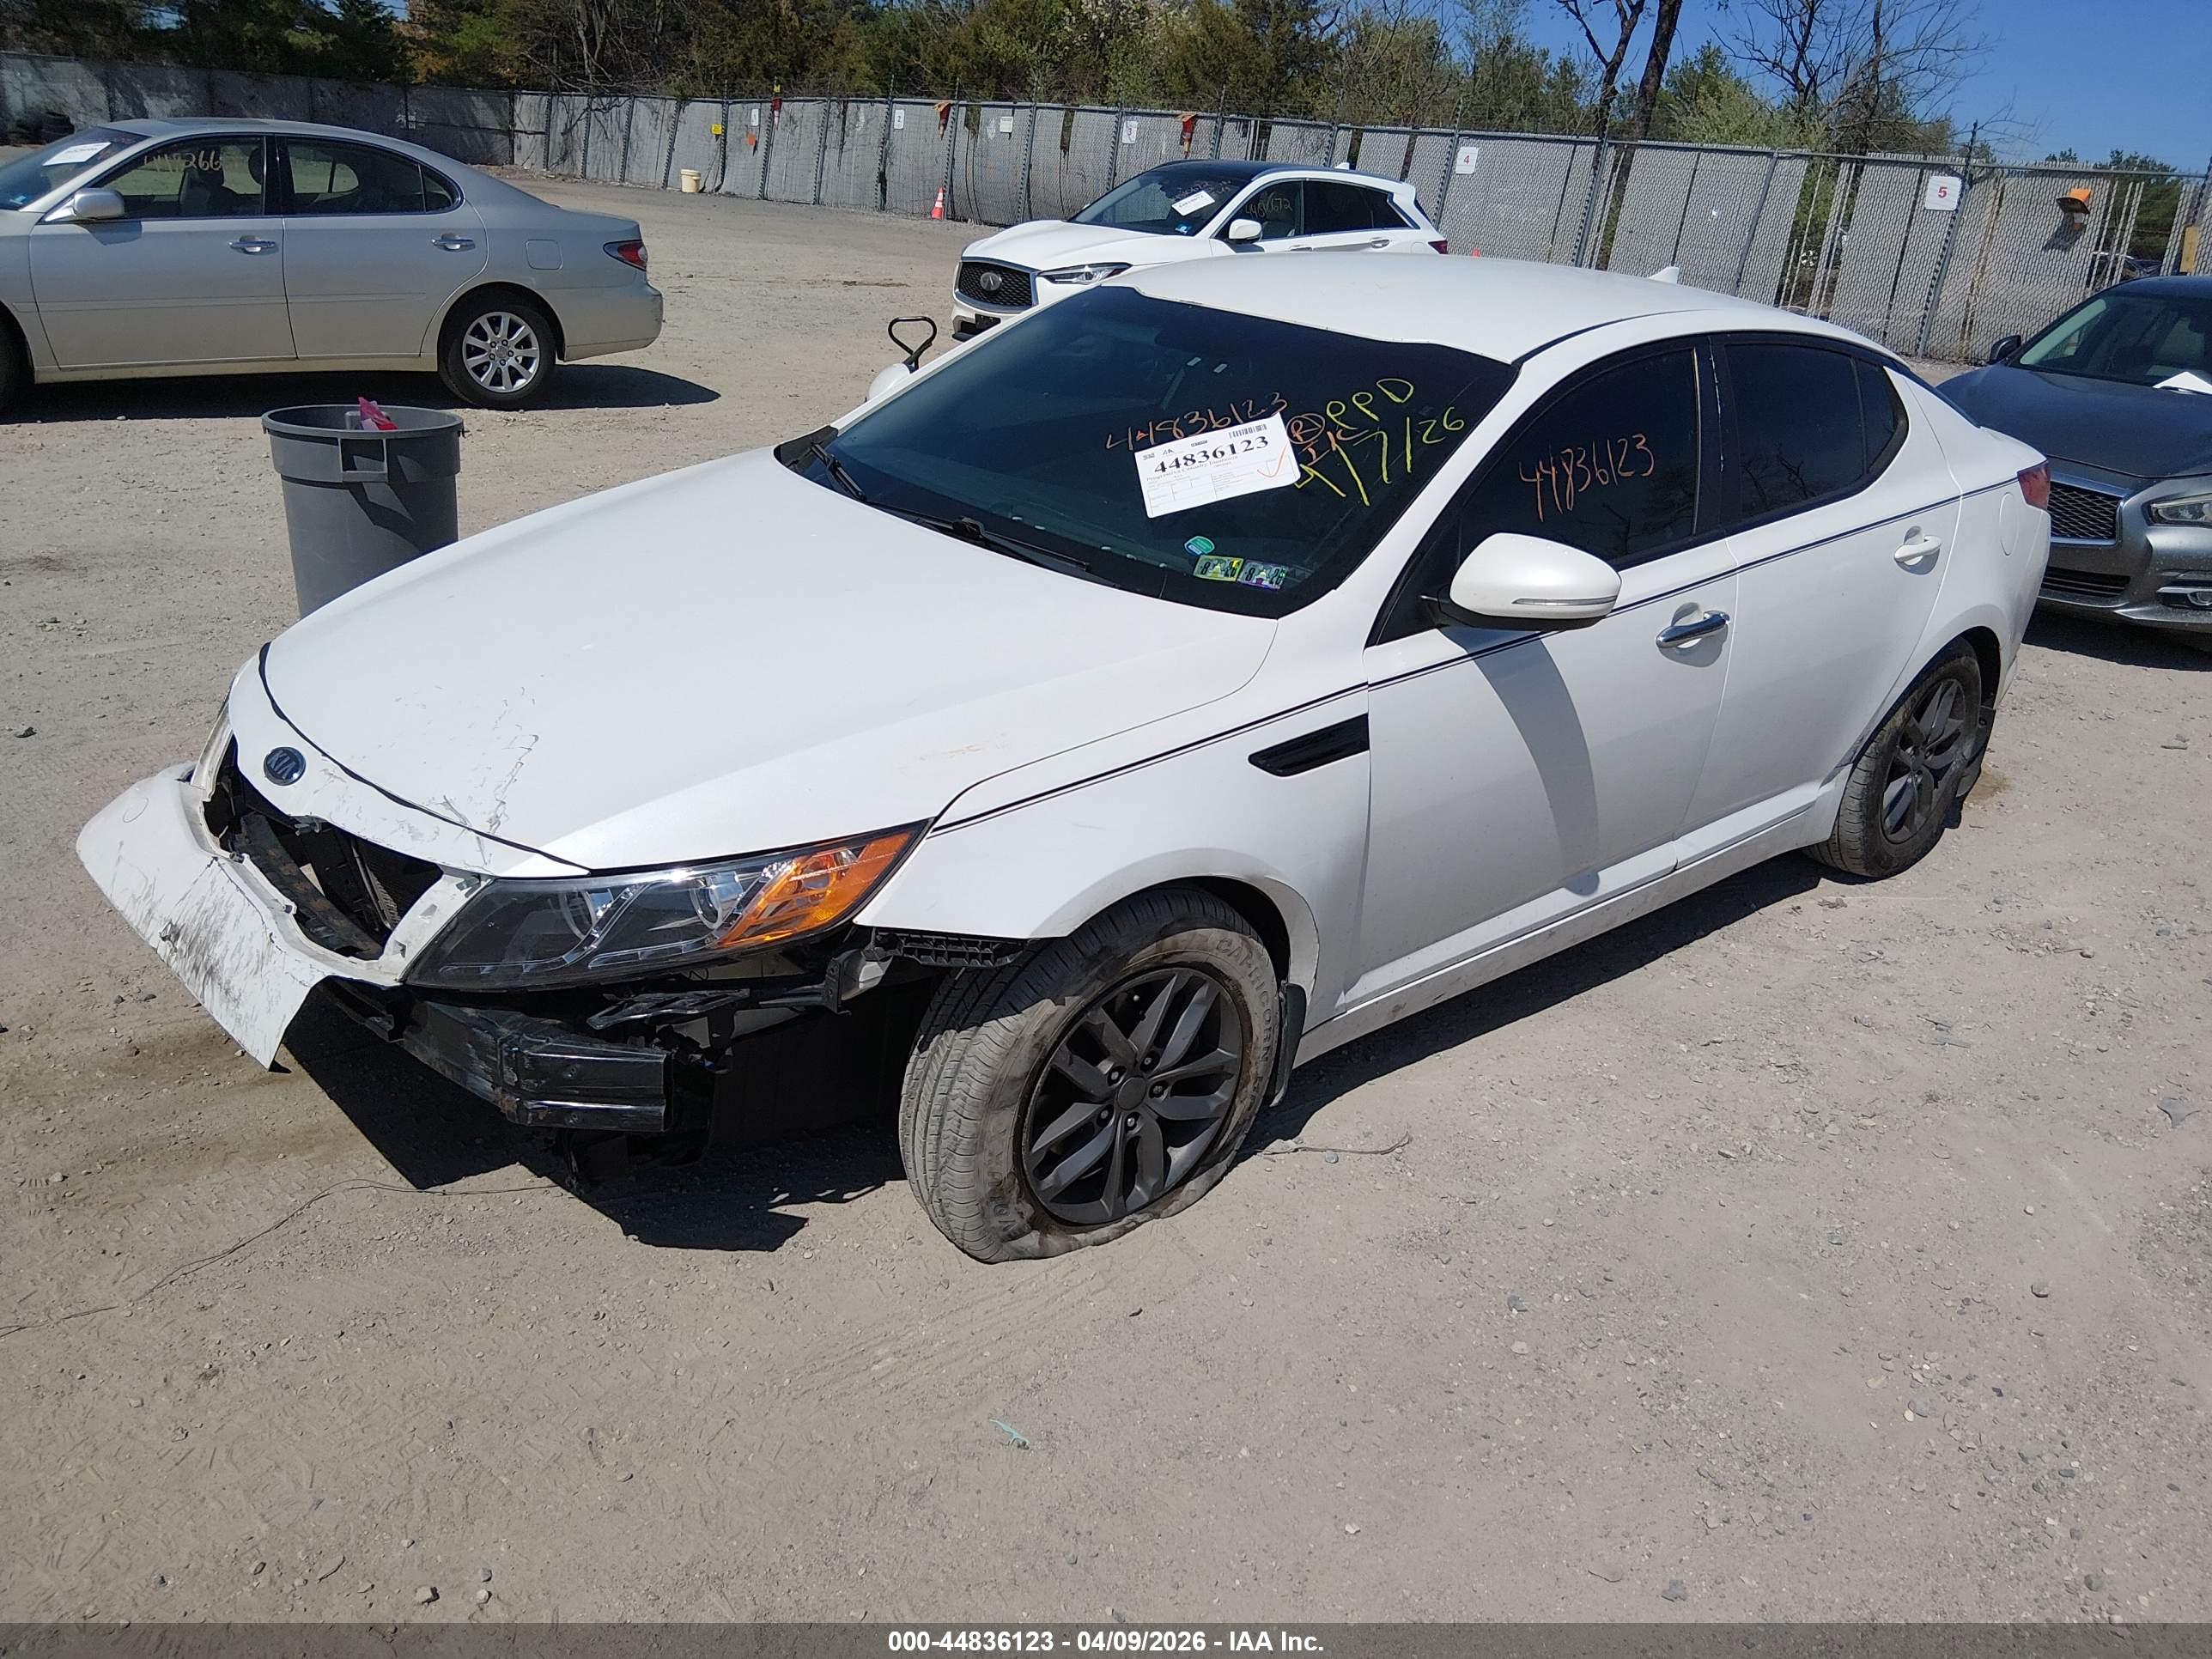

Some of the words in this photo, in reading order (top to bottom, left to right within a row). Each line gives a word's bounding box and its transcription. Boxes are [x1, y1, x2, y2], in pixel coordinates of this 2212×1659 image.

[1463, 155, 1469, 165] 4
[1079, 186, 1089, 198] 5
[1106, 392, 1288, 450] 44836123
[1154, 435, 1268, 472] 44836123
[1519, 433, 1655, 523] 44836123
[1201, 562, 1211, 575] 8
[1246, 568, 1255, 581] 8
